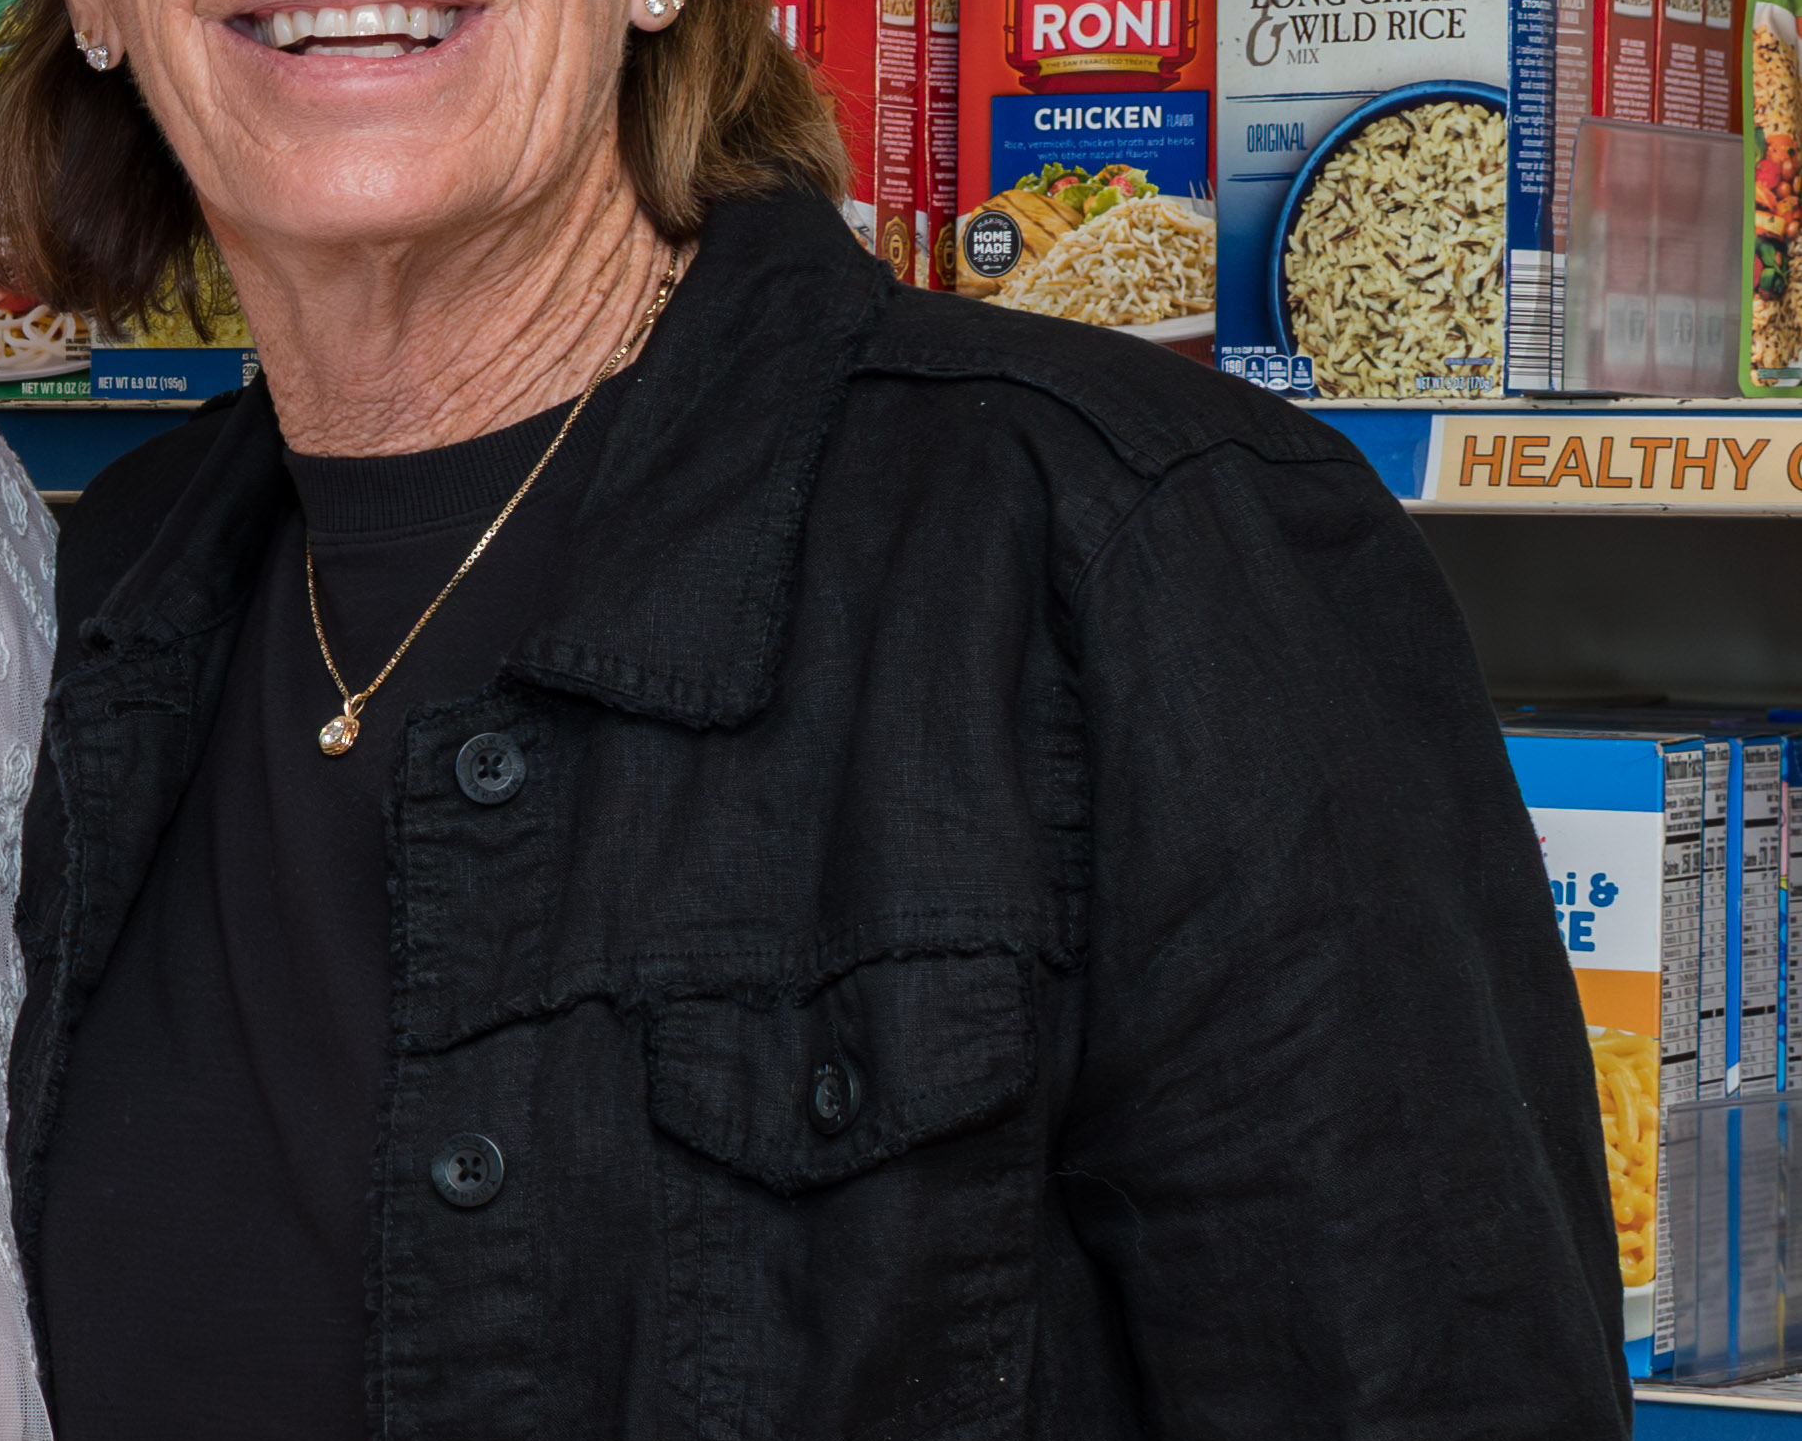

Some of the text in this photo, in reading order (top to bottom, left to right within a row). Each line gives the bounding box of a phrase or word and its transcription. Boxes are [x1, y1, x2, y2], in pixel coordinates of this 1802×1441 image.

[1288, 10, 1377, 45] WILD
[1387, 7, 1468, 42] RICE
[1286, 47, 1320, 66] MIX
[1033, 105, 1163, 131] CHICKEN
[1246, 122, 1308, 153] ORIGINAL
[972, 242, 1013, 256] MADE
[973, 229, 1013, 244] HOME
[1459, 435, 1771, 491] HEALTHY
